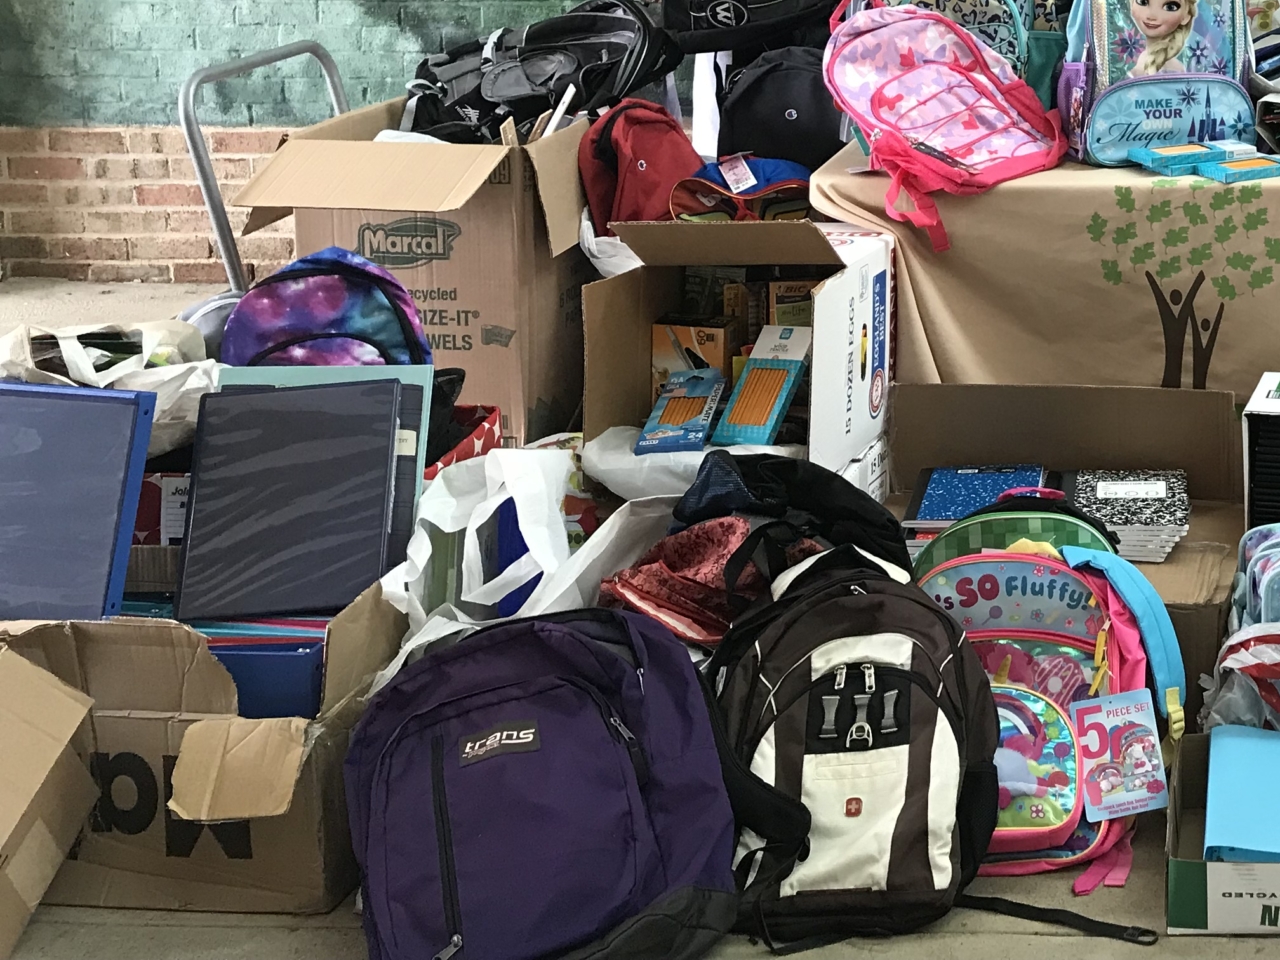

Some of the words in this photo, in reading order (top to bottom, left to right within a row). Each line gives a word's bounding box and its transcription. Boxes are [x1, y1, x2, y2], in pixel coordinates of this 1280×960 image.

[1134, 98, 1173, 110] MAKE
[1143, 108, 1183, 119] YOUR
[1097, 122, 1181, 147] Magic
[1142, 119, 1173, 130] OWN
[363, 226, 446, 259] Marcal
[407, 288, 458, 304] ecycled
[847, 296, 855, 347] EGGS
[873, 282, 881, 368] EGGLAND'S
[426, 334, 473, 351] WELS
[845, 351, 855, 414] DOZEN
[845, 416, 852, 437] 15
[955, 573, 1000, 608] SO
[1004, 575, 1093, 611] Fluffy!
[464, 728, 536, 752] trans
[1075, 704, 1110, 760] 5
[1106, 705, 1132, 719] PIECE
[1134, 701, 1151, 712] SET
